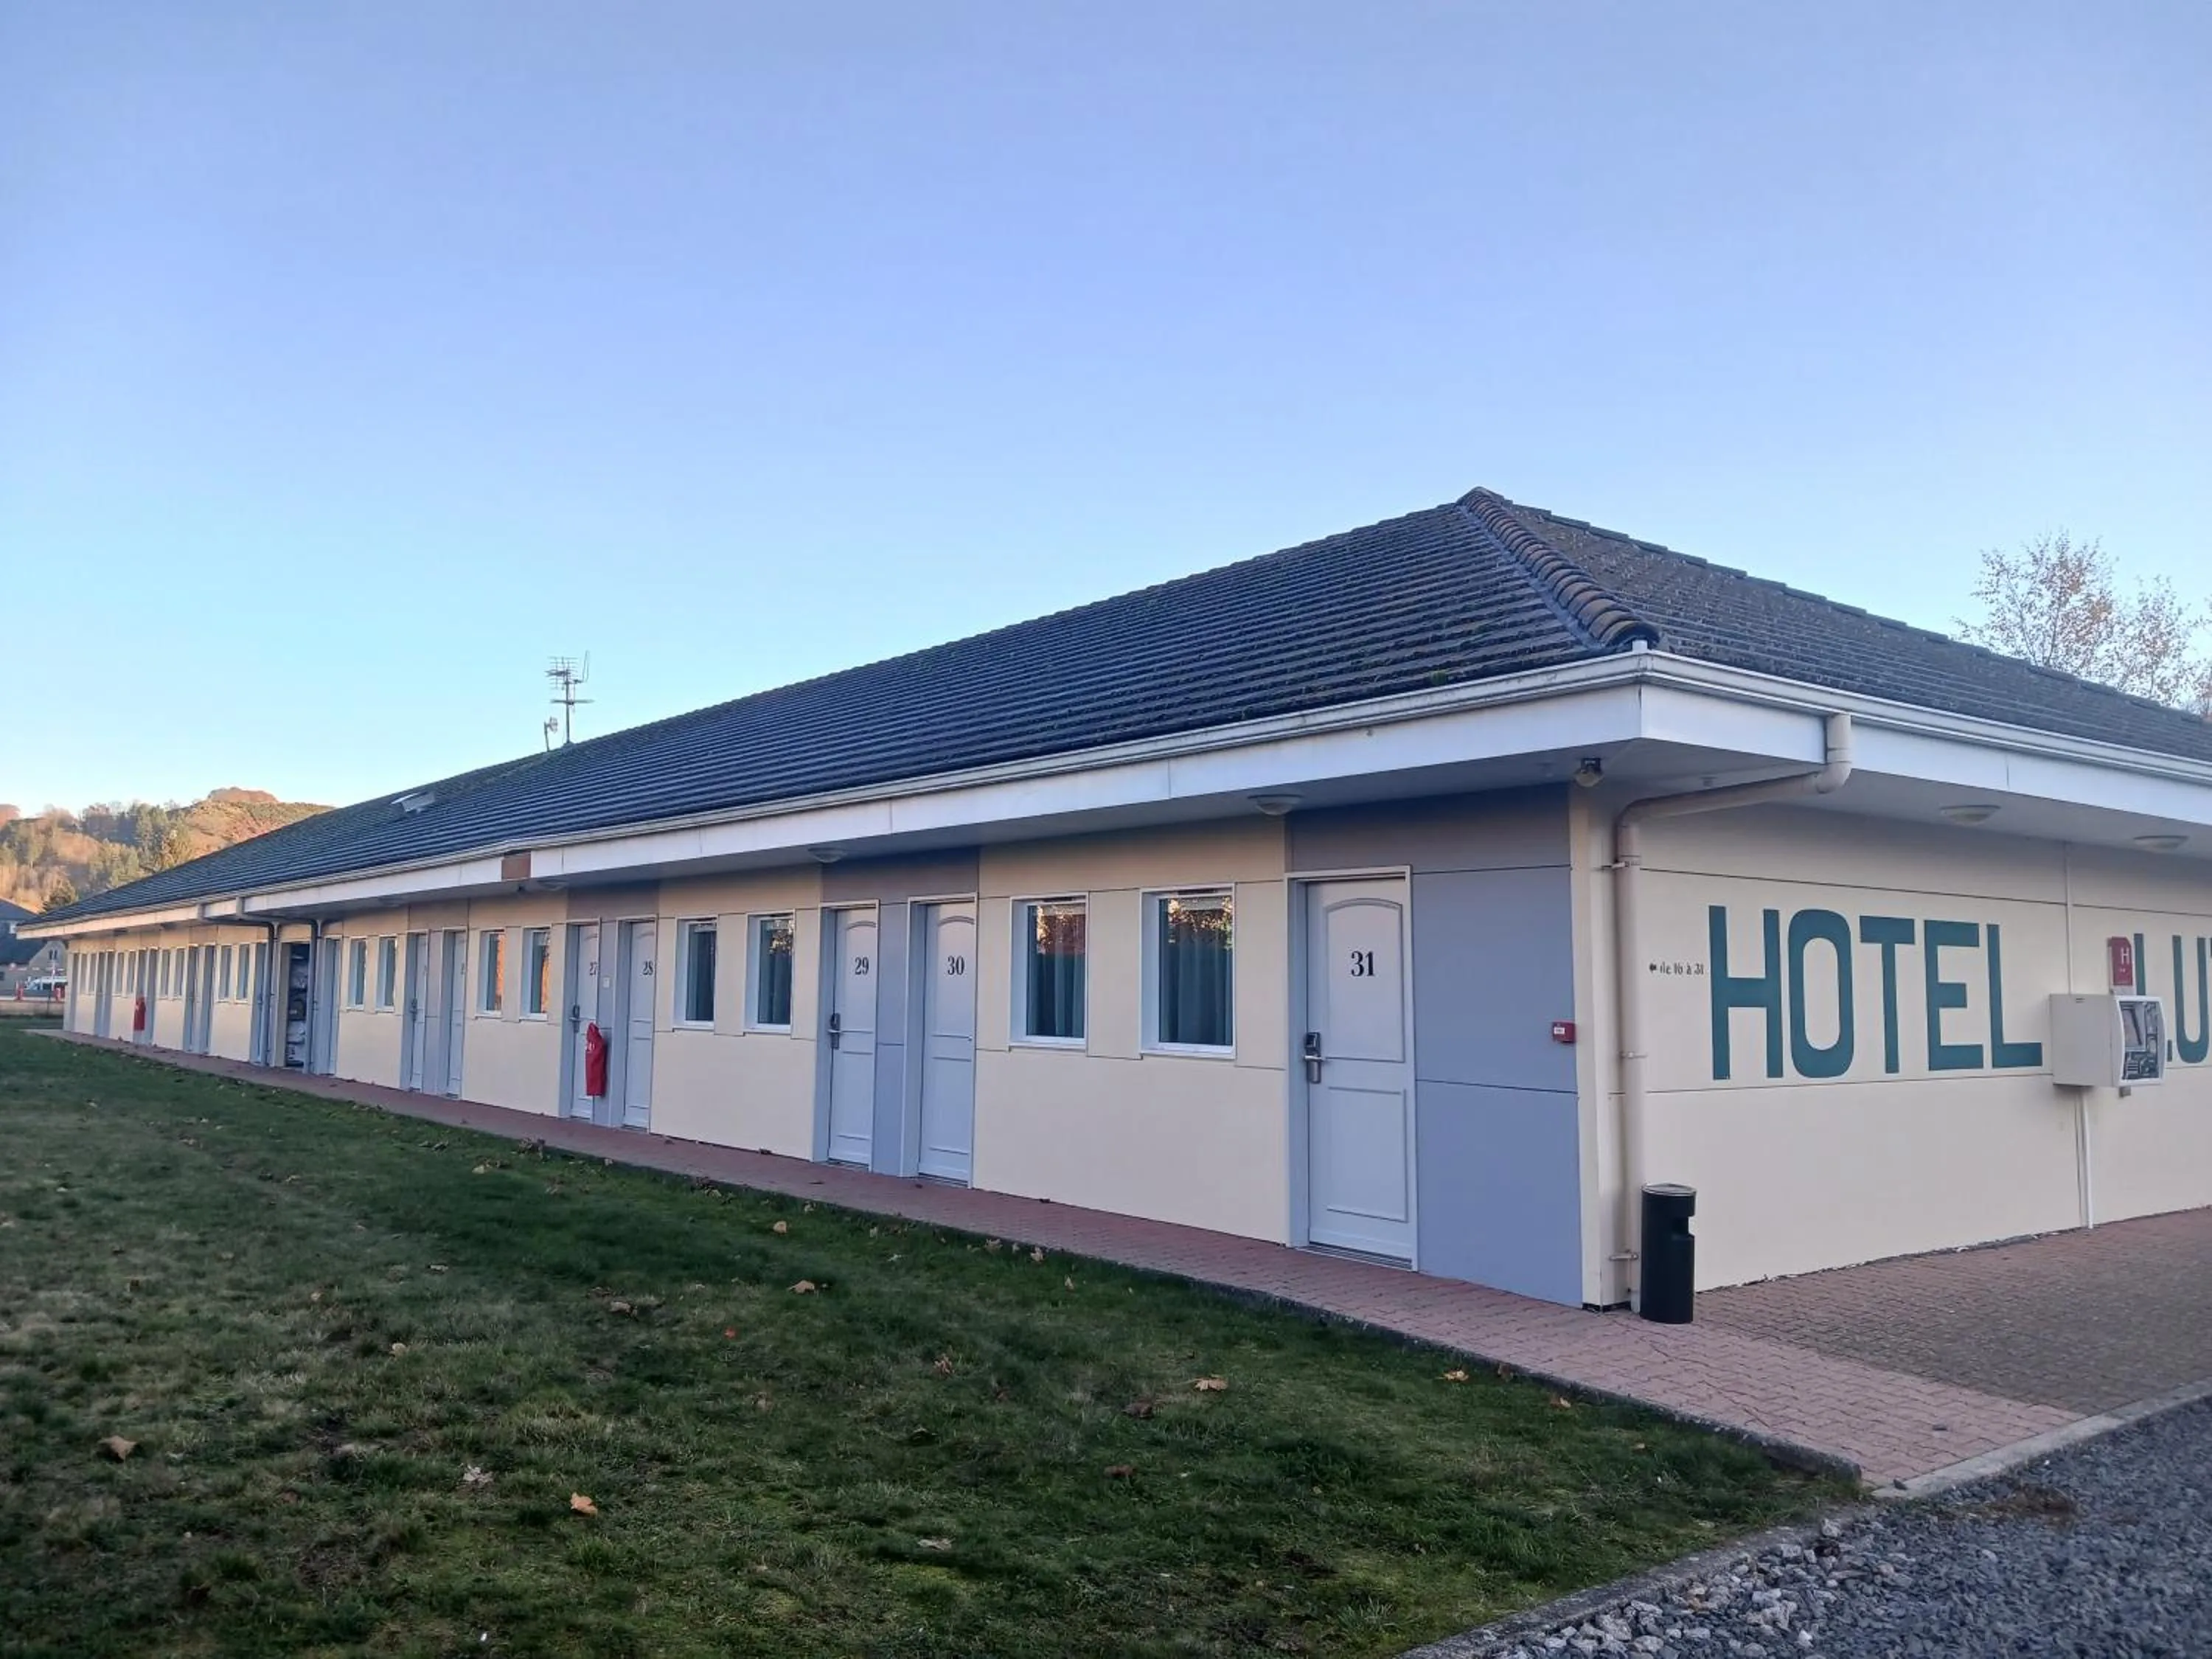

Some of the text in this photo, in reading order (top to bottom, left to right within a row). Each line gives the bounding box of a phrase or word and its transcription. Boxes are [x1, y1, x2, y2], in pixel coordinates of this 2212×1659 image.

[1350, 950, 1375, 977] 31
[2120, 947, 2130, 965] H
[643, 961, 654, 975] 28
[855, 957, 869, 975] 29
[947, 956, 965, 975] 30
[1694, 963, 1704, 975] 31
[1708, 905, 2212, 1080] HOTEL LU
